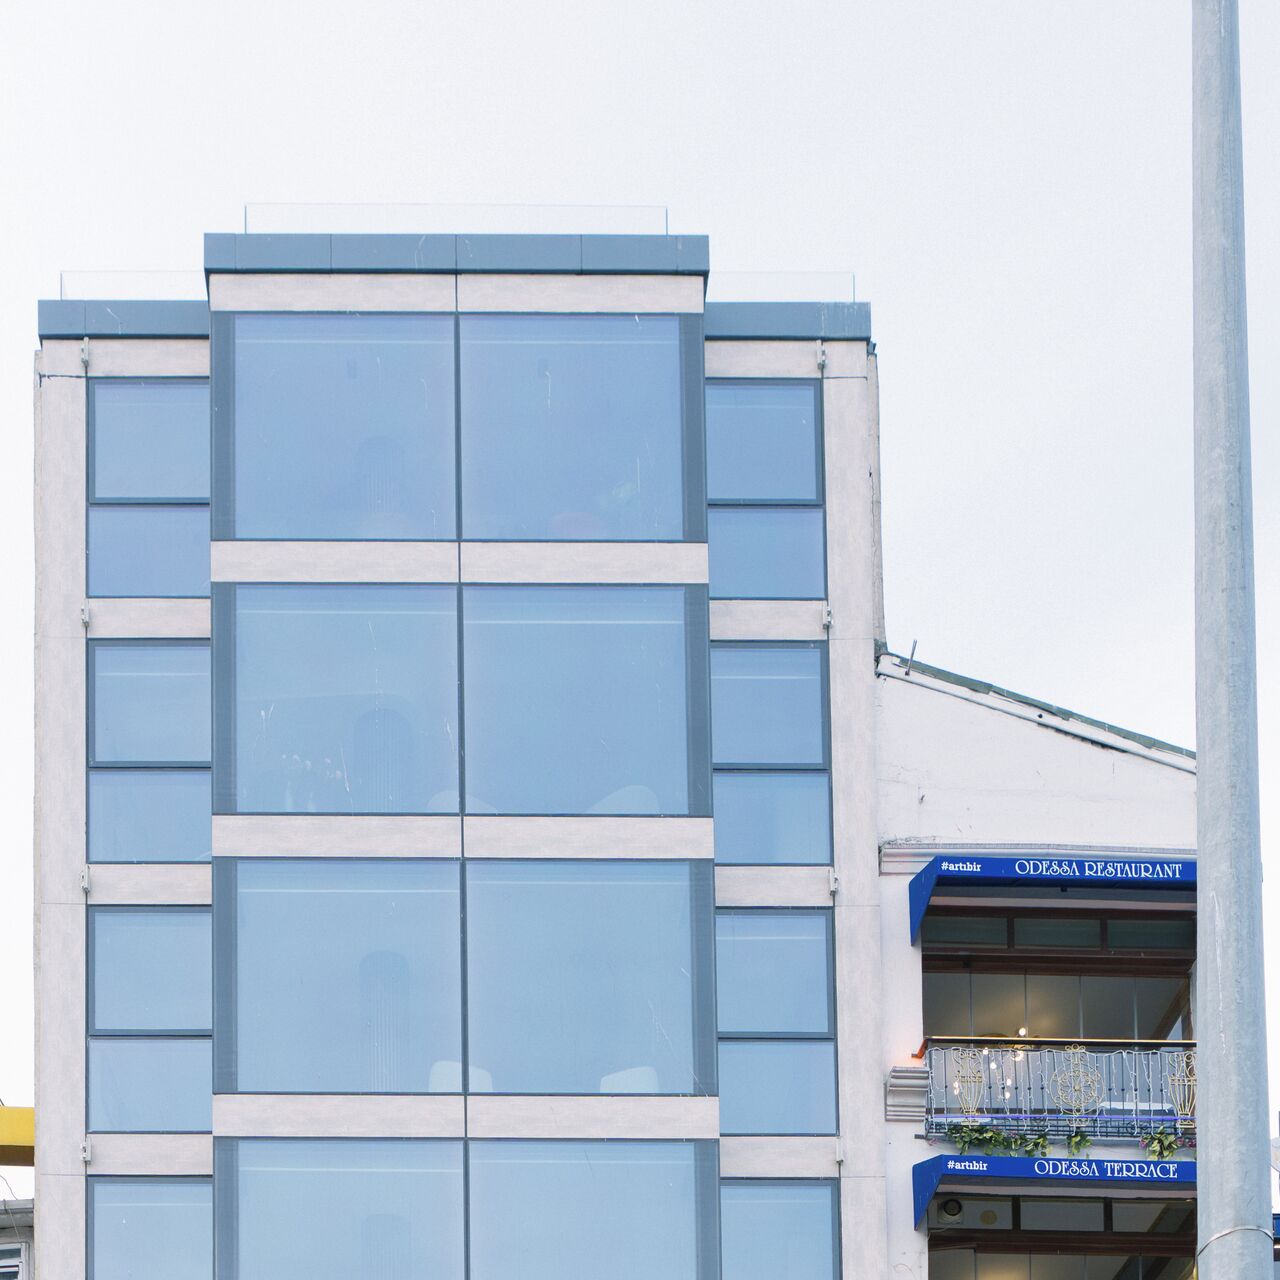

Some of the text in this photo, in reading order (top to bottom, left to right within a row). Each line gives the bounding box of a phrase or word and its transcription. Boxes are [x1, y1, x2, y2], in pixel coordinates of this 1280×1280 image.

[1015, 860, 1079, 876] ODESSA
[1084, 862, 1182, 878] RESTAURANT
[1035, 1160, 1099, 1177] ODESSA
[1104, 1162, 1177, 1179] TERRACE
